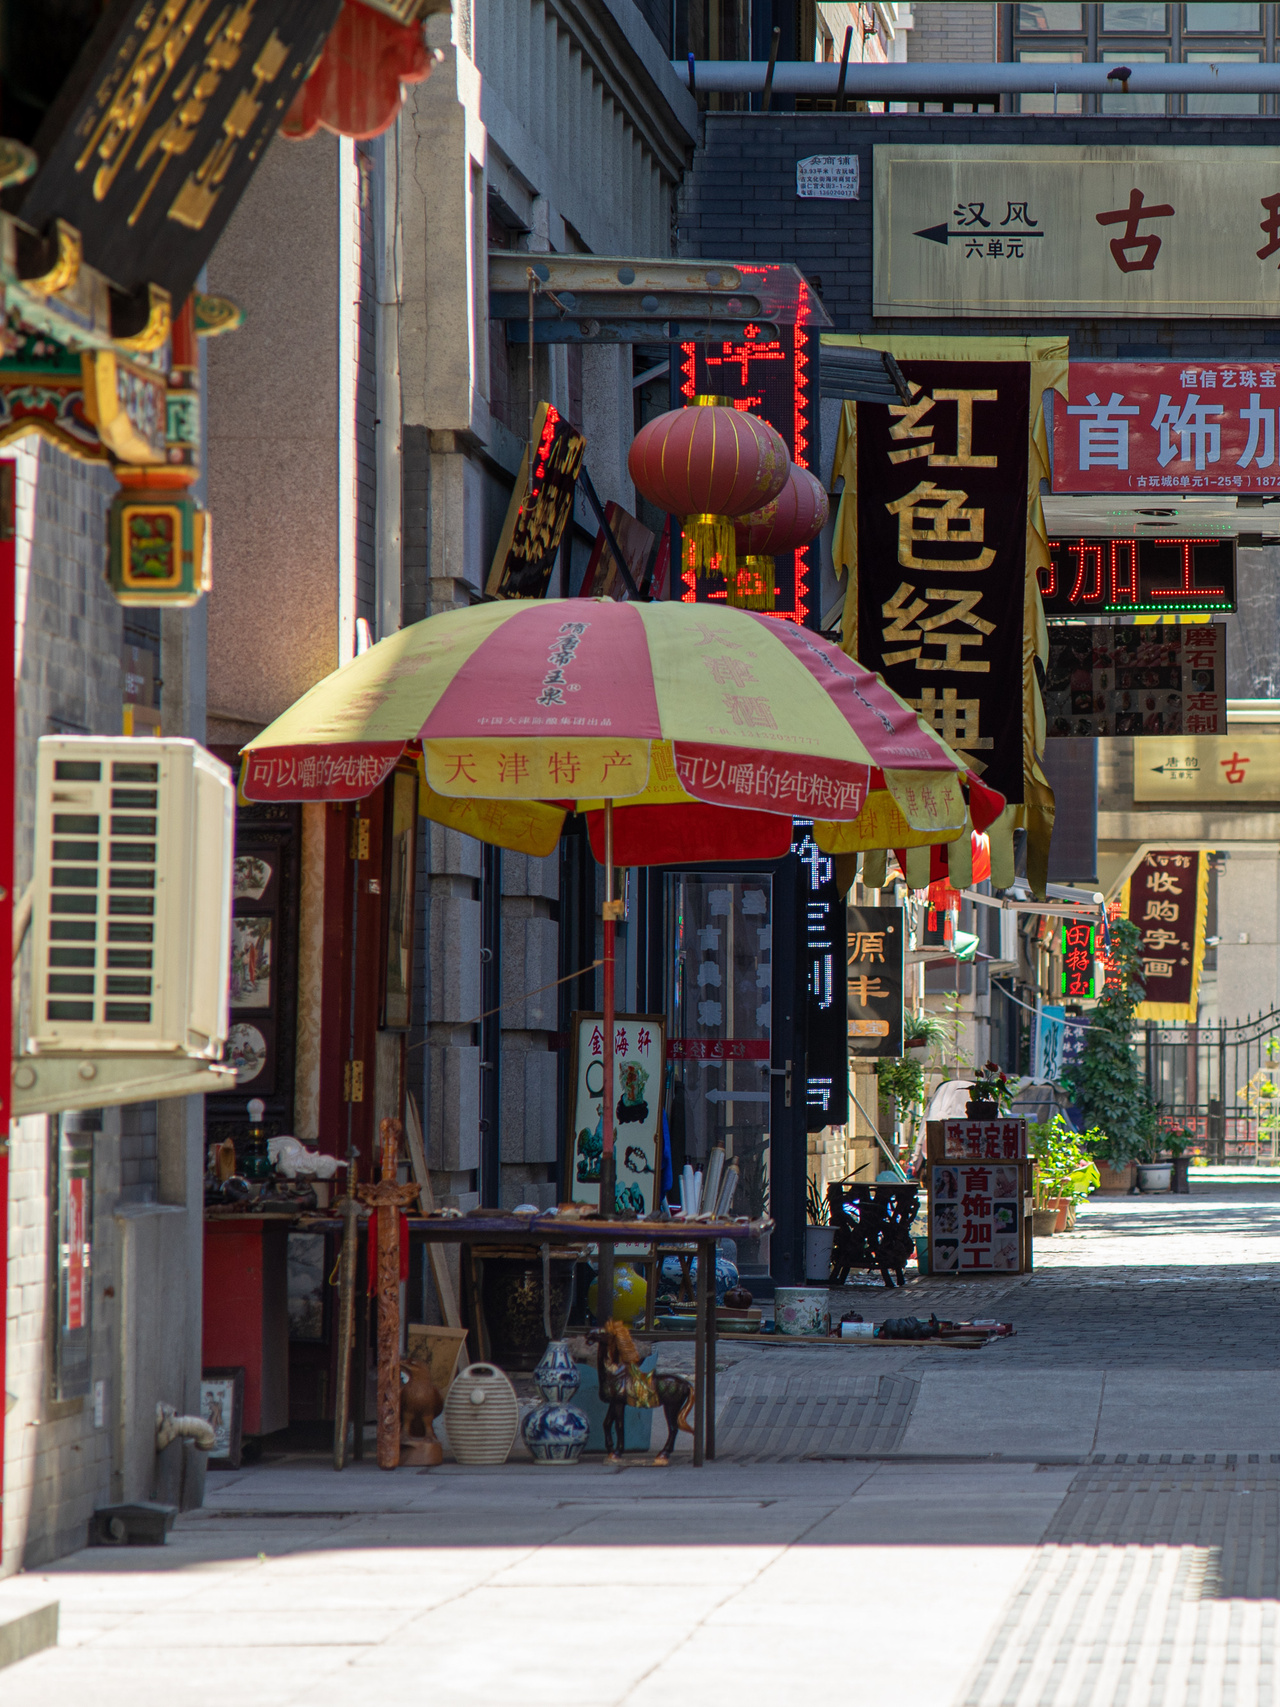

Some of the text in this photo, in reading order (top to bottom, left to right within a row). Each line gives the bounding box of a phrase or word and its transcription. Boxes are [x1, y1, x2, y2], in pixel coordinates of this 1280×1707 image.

[953, 201, 1038, 228] 汉风
[965, 238, 1024, 258] 六单元
[1180, 370, 1278, 389] 恒信艺珠宝
[881, 381, 998, 774] 红色经典
[444, 750, 632, 784] 天津特产
[677, 754, 863, 812] 可以嚼的纯粮酒
[1143, 871, 1183, 978] 收购字画
[588, 1025, 652, 1057] 金海轩
[961, 1167, 993, 1269] 首饰加工
